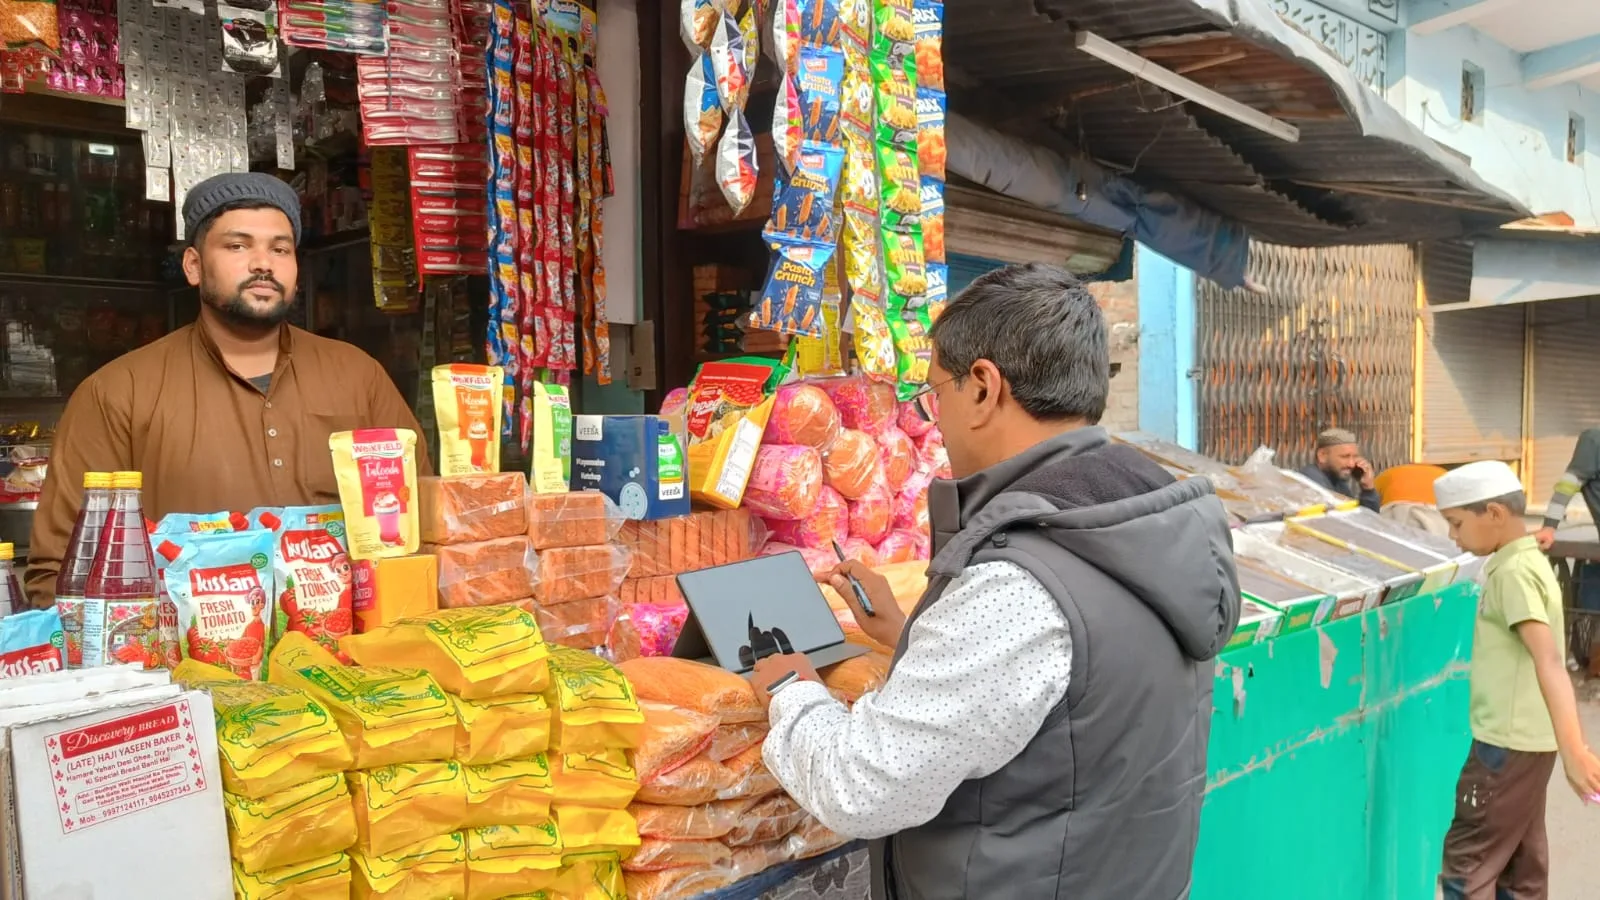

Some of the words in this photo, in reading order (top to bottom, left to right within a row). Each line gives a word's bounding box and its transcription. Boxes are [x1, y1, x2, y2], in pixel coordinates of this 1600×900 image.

[783, 262, 812, 275] Pasta
[200, 599, 235, 616] FRESH
[201, 611, 246, 630] TOMATO
[67, 724, 136, 751] Discovery
[138, 715, 175, 731] BREAD
[66, 755, 96, 773] (LATE)
[98, 750, 117, 763] HAJI
[119, 740, 151, 757] YASEEN
[153, 732, 181, 747] BAKER
[154, 749, 166, 758] Dry
[94, 770, 119, 783] Special
[120, 764, 140, 774] Bread
